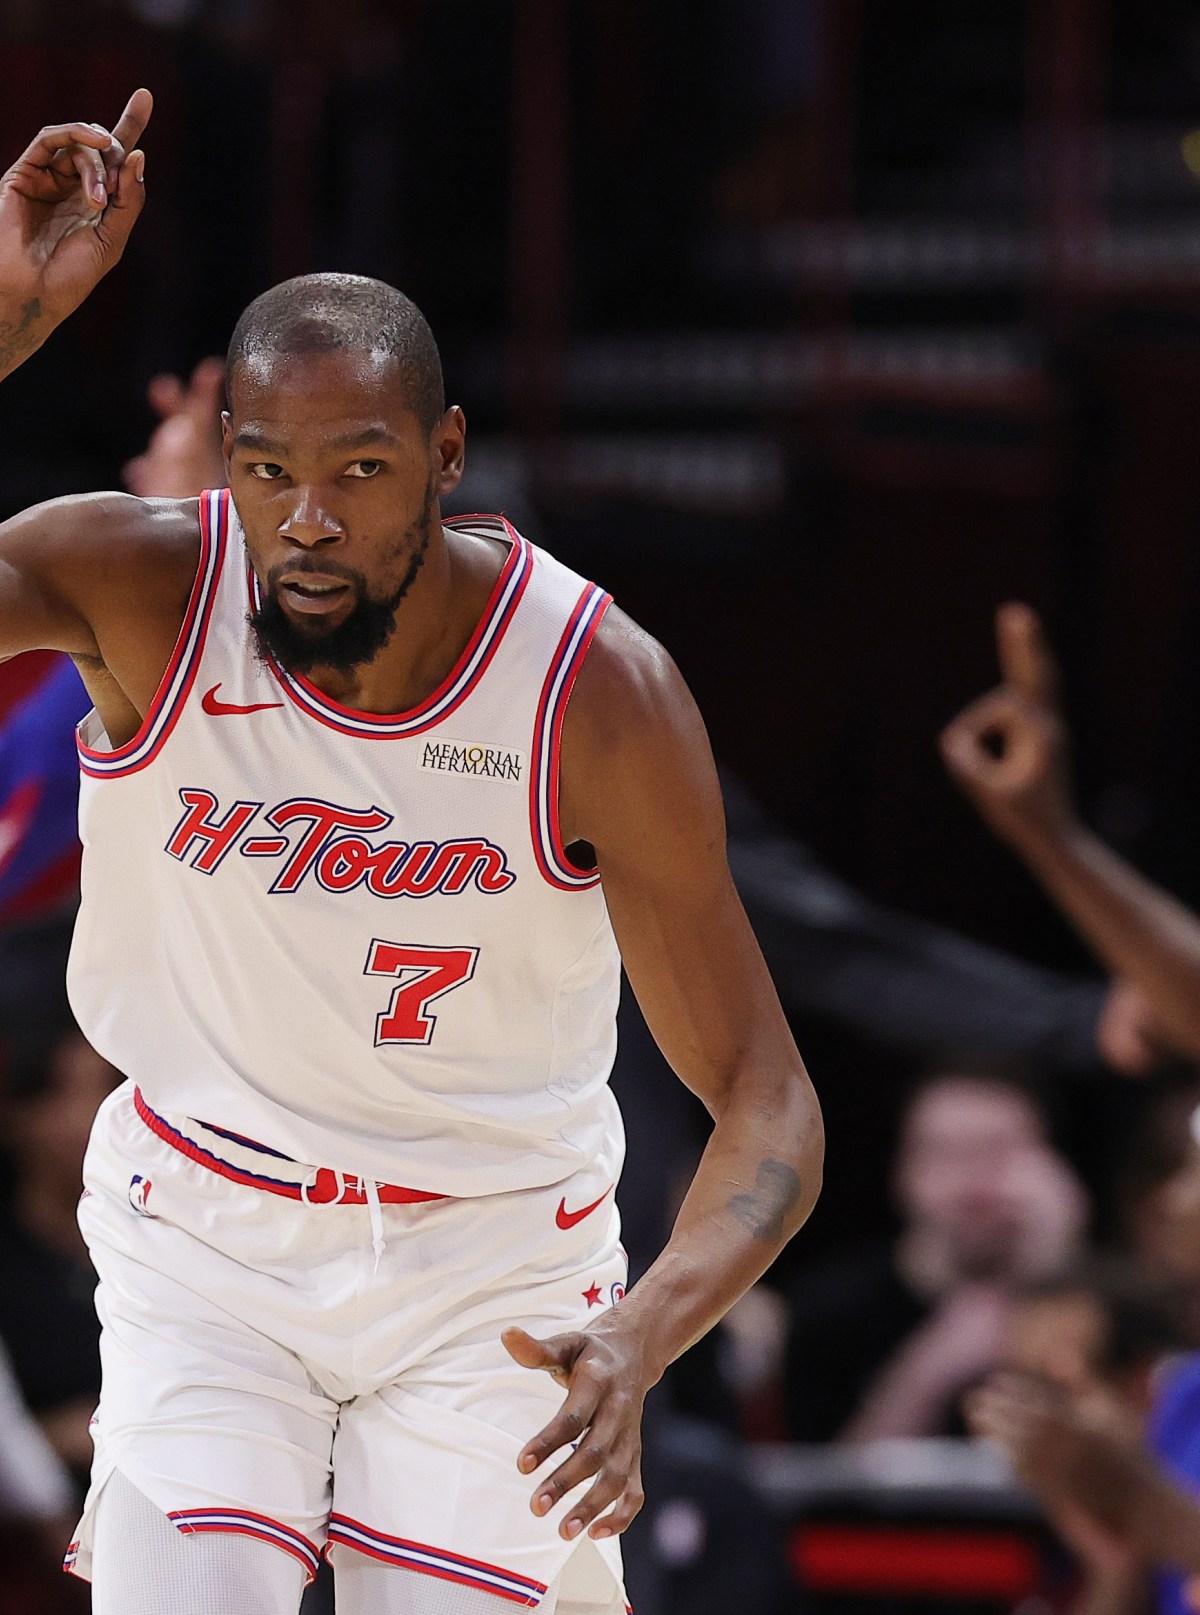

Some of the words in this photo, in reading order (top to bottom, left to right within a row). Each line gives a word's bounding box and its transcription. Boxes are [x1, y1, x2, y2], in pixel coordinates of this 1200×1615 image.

[422, 753, 520, 781] HERMANN
[423, 742, 522, 770] MEMORIAL
[164, 788, 516, 898] H-Town
[363, 938, 480, 1047] 7
